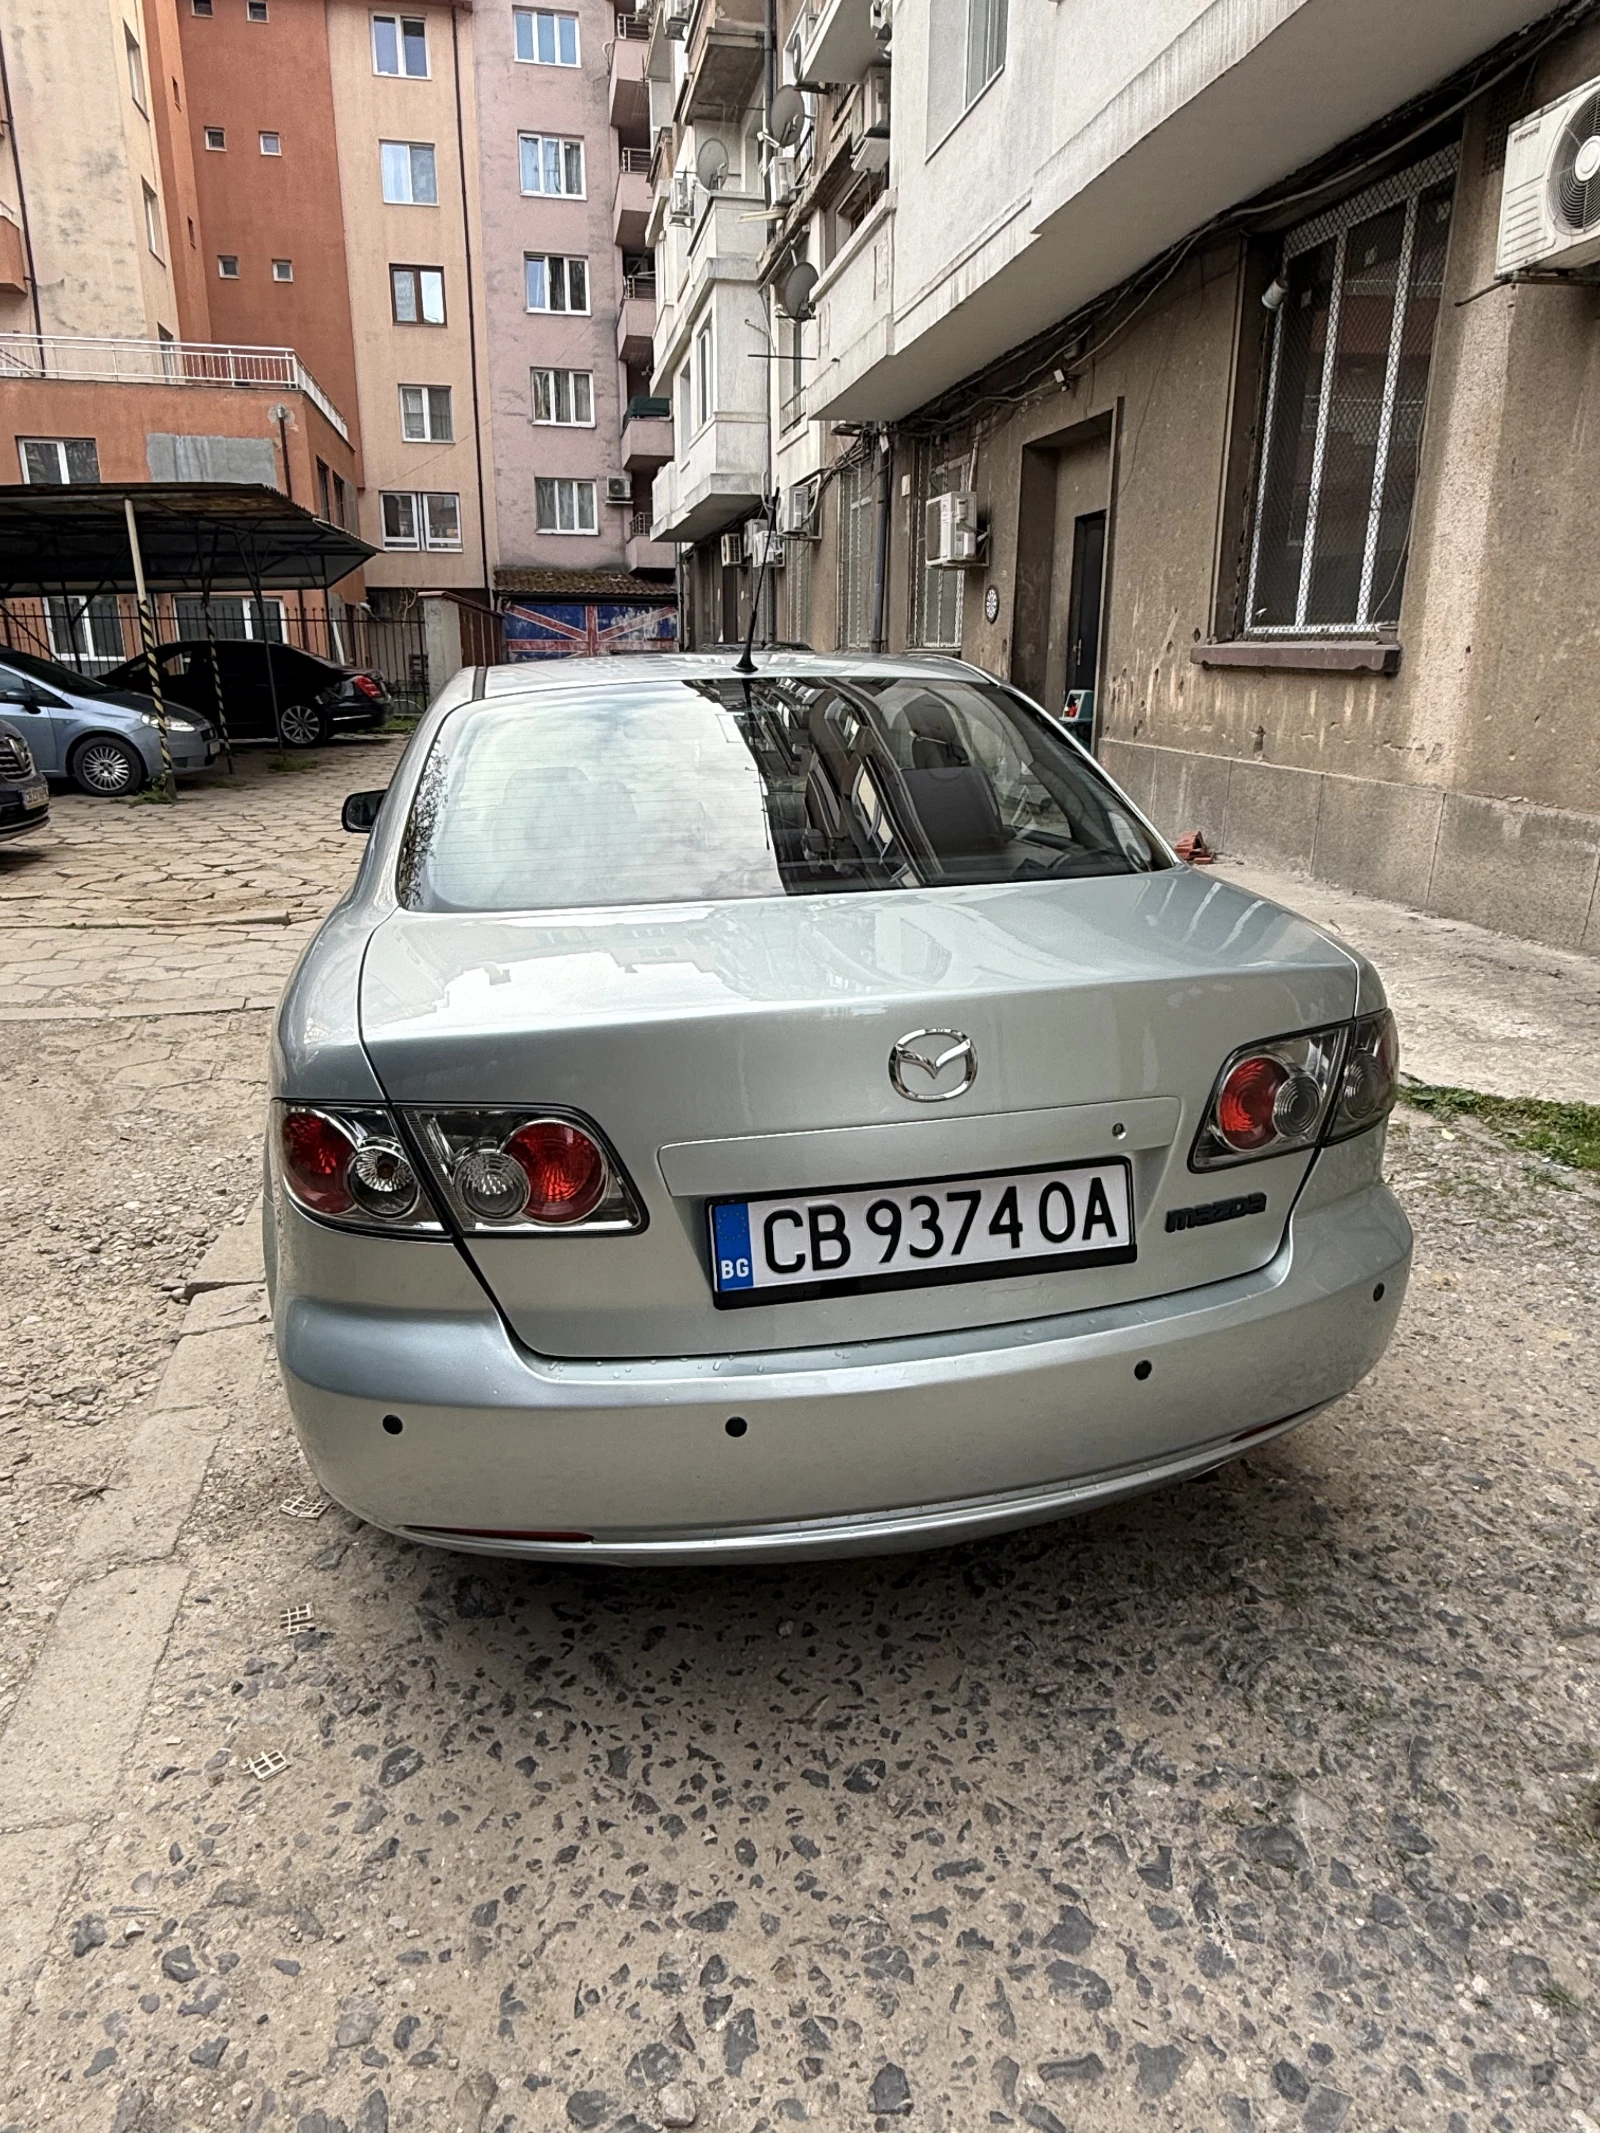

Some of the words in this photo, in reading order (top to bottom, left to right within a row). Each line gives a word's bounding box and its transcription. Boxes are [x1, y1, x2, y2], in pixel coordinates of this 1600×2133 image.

[764, 1205, 851, 1273] CB
[866, 1187, 1022, 1263] 9374
[1039, 1177, 1117, 1243] OA
[720, 1257, 750, 1280] BG
